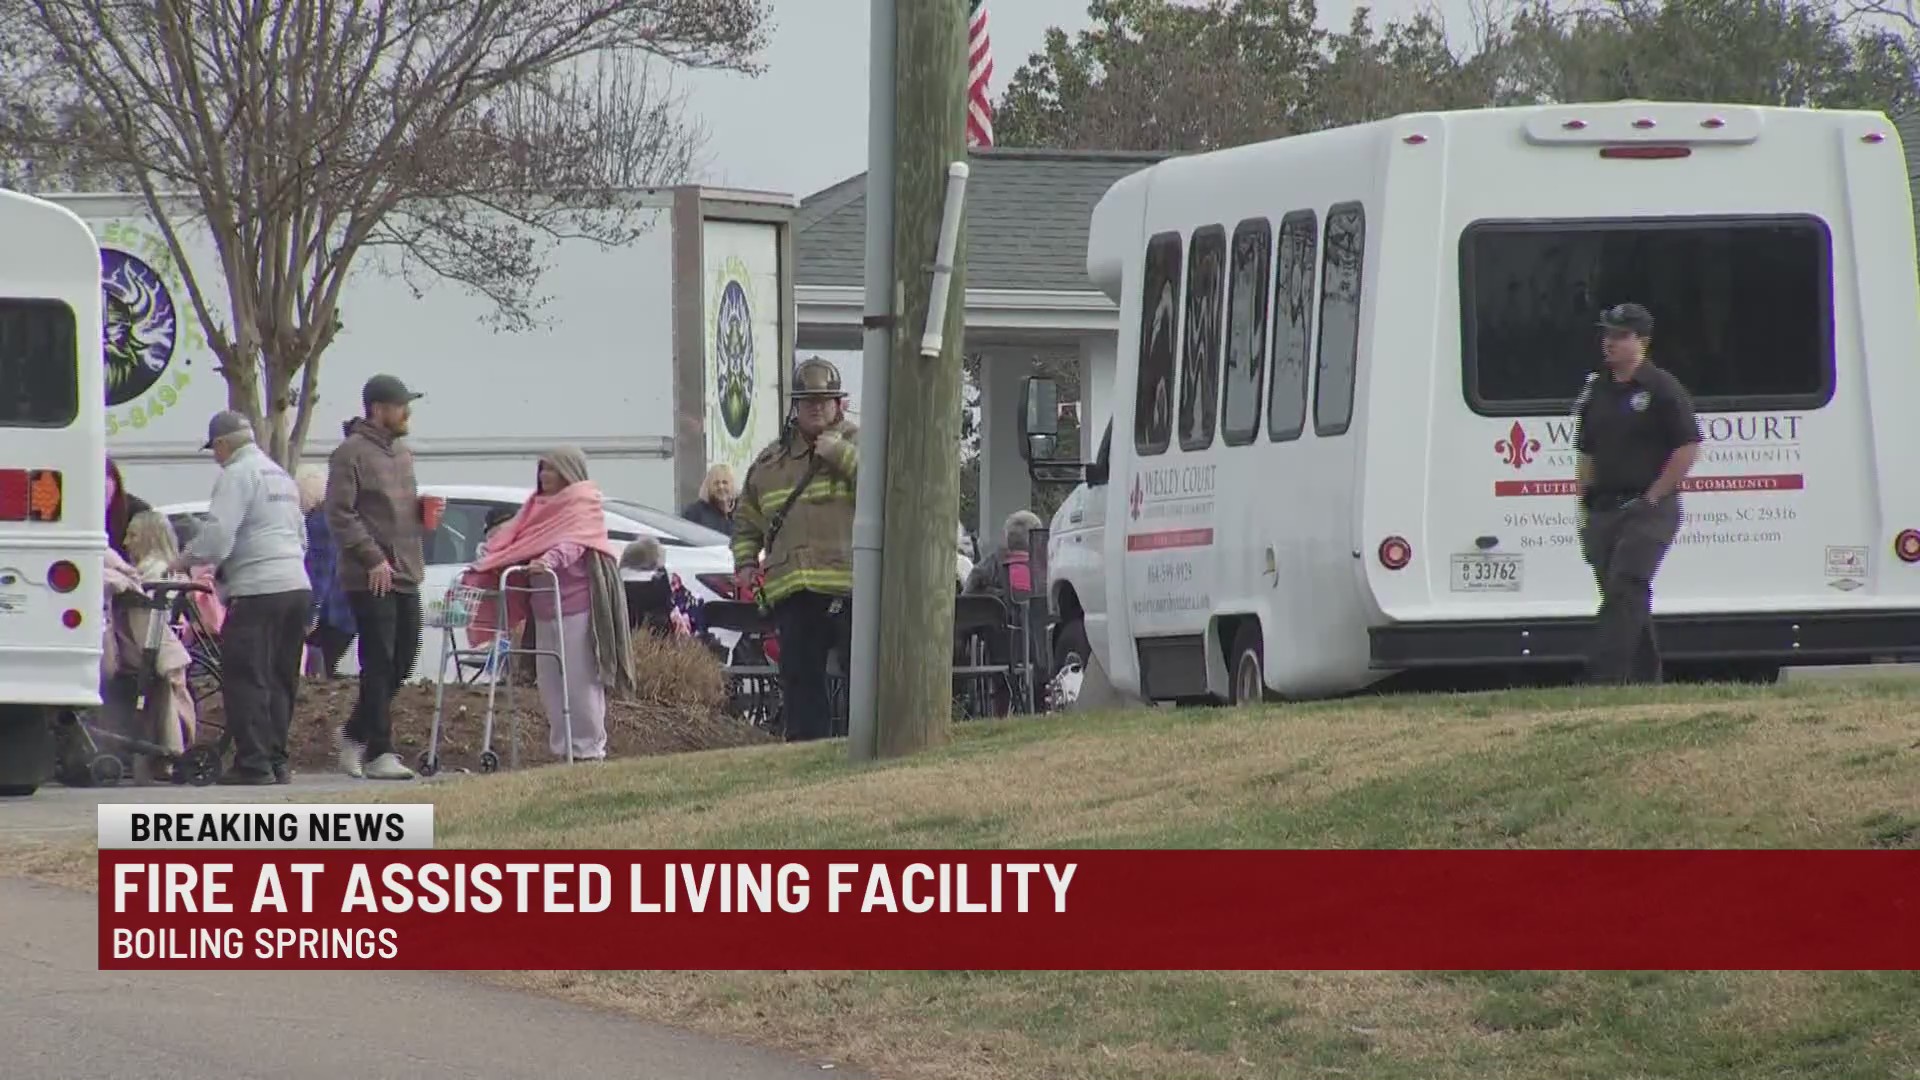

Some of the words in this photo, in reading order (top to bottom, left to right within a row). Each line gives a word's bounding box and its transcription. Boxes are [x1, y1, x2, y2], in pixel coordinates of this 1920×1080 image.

[1702, 415, 1802, 441] OURT
[1707, 447, 1800, 462] OMMUNITY
[1145, 468, 1179, 496] WESLEY
[1183, 464, 1217, 493] COURT
[1535, 483, 1577, 494] TUTER
[1696, 479, 1778, 490] COMMUNITY
[1504, 513, 1528, 527] 916
[1736, 507, 1755, 521] SC
[1757, 506, 1797, 521] 29316
[1475, 562, 1517, 580] 33762
